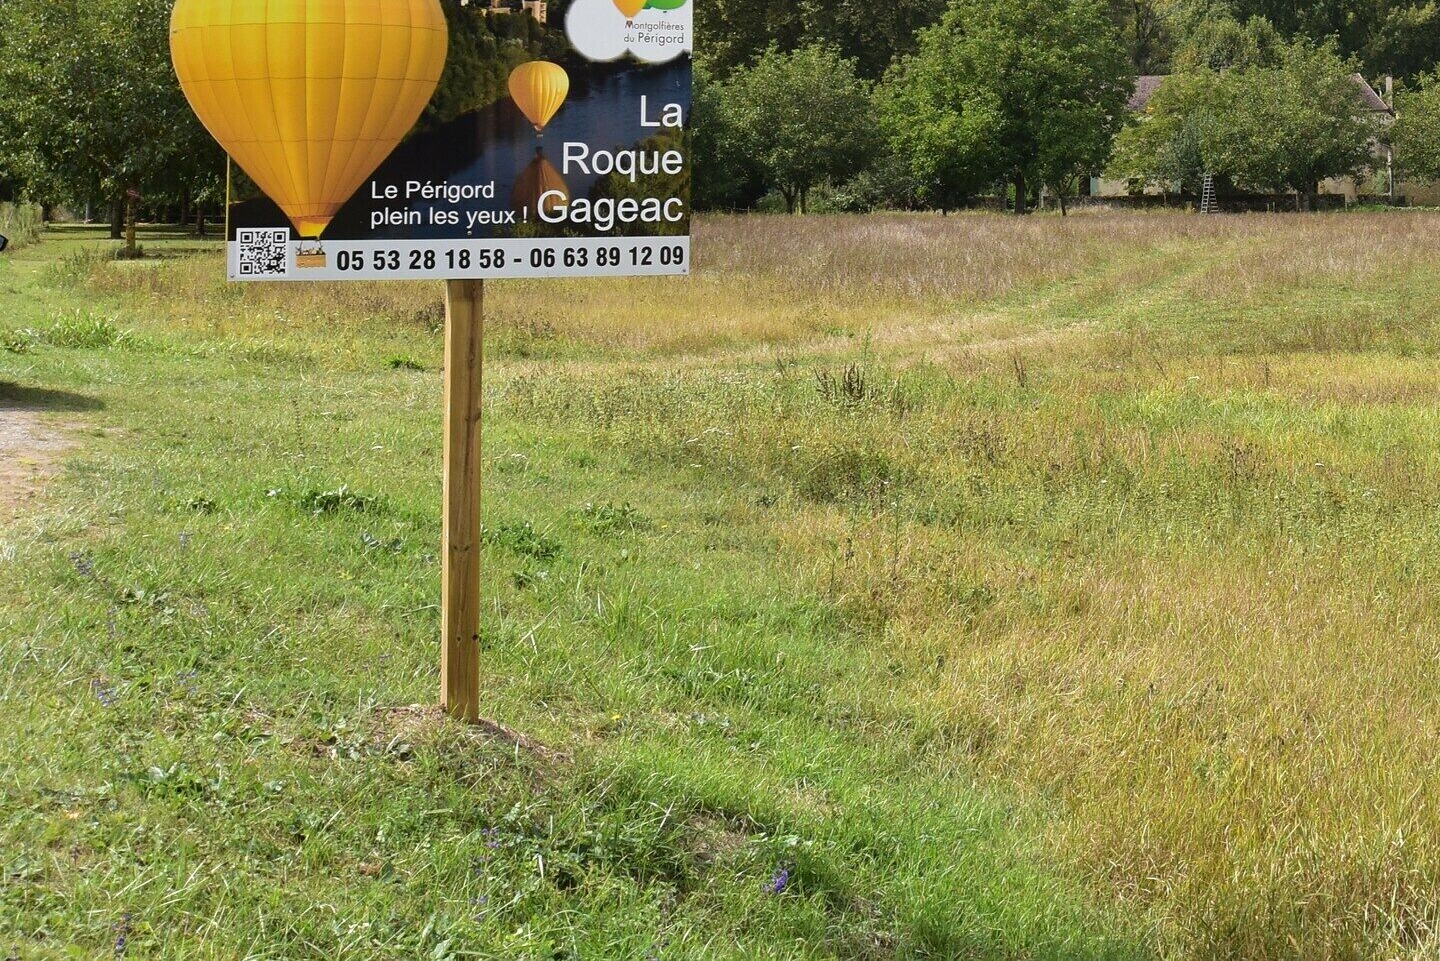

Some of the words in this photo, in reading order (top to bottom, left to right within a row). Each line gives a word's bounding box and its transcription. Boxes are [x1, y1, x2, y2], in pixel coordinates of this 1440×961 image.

[624, 20, 685, 32] Montgolfières
[623, 33, 635, 43] du
[637, 32, 685, 46] Périgord
[640, 94, 683, 128] La
[562, 141, 684, 183] Roque
[371, 180, 398, 199] Le
[405, 180, 495, 203] Périgord
[370, 206, 422, 230] plein
[429, 206, 459, 225] les
[466, 209, 516, 229] yeux
[537, 189, 684, 231] Gageac
[336, 250, 364, 271] 05
[372, 250, 400, 271] 53
[408, 249, 436, 270] 28
[444, 249, 471, 269] 18
[479, 248, 505, 269] 58
[529, 248, 556, 268] 06
[563, 247, 589, 267] 63
[596, 246, 621, 267] 89
[628, 246, 653, 266] 12
[659, 245, 684, 266] 09
